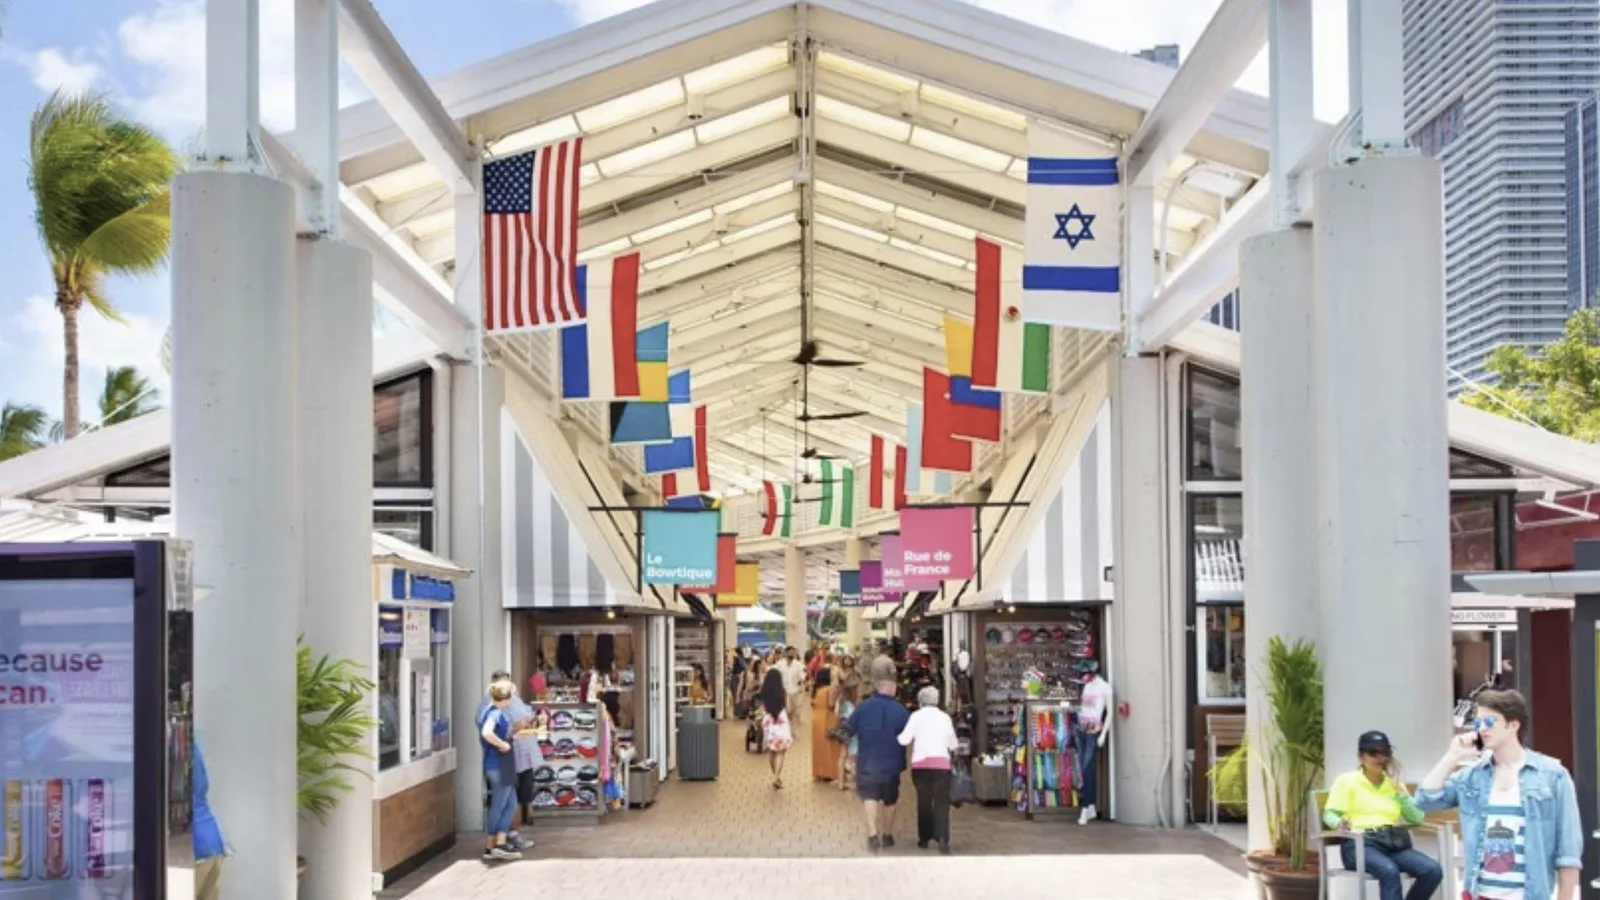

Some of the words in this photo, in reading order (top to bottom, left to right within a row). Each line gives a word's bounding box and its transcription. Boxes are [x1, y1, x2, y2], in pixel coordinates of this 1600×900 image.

[647, 553, 662, 564] Le
[903, 550, 930, 561] Rue
[934, 550, 951, 561] de
[647, 566, 712, 579] Bowtique
[903, 564, 950, 575] France
[1466, 611, 1506, 621] FLOWER
